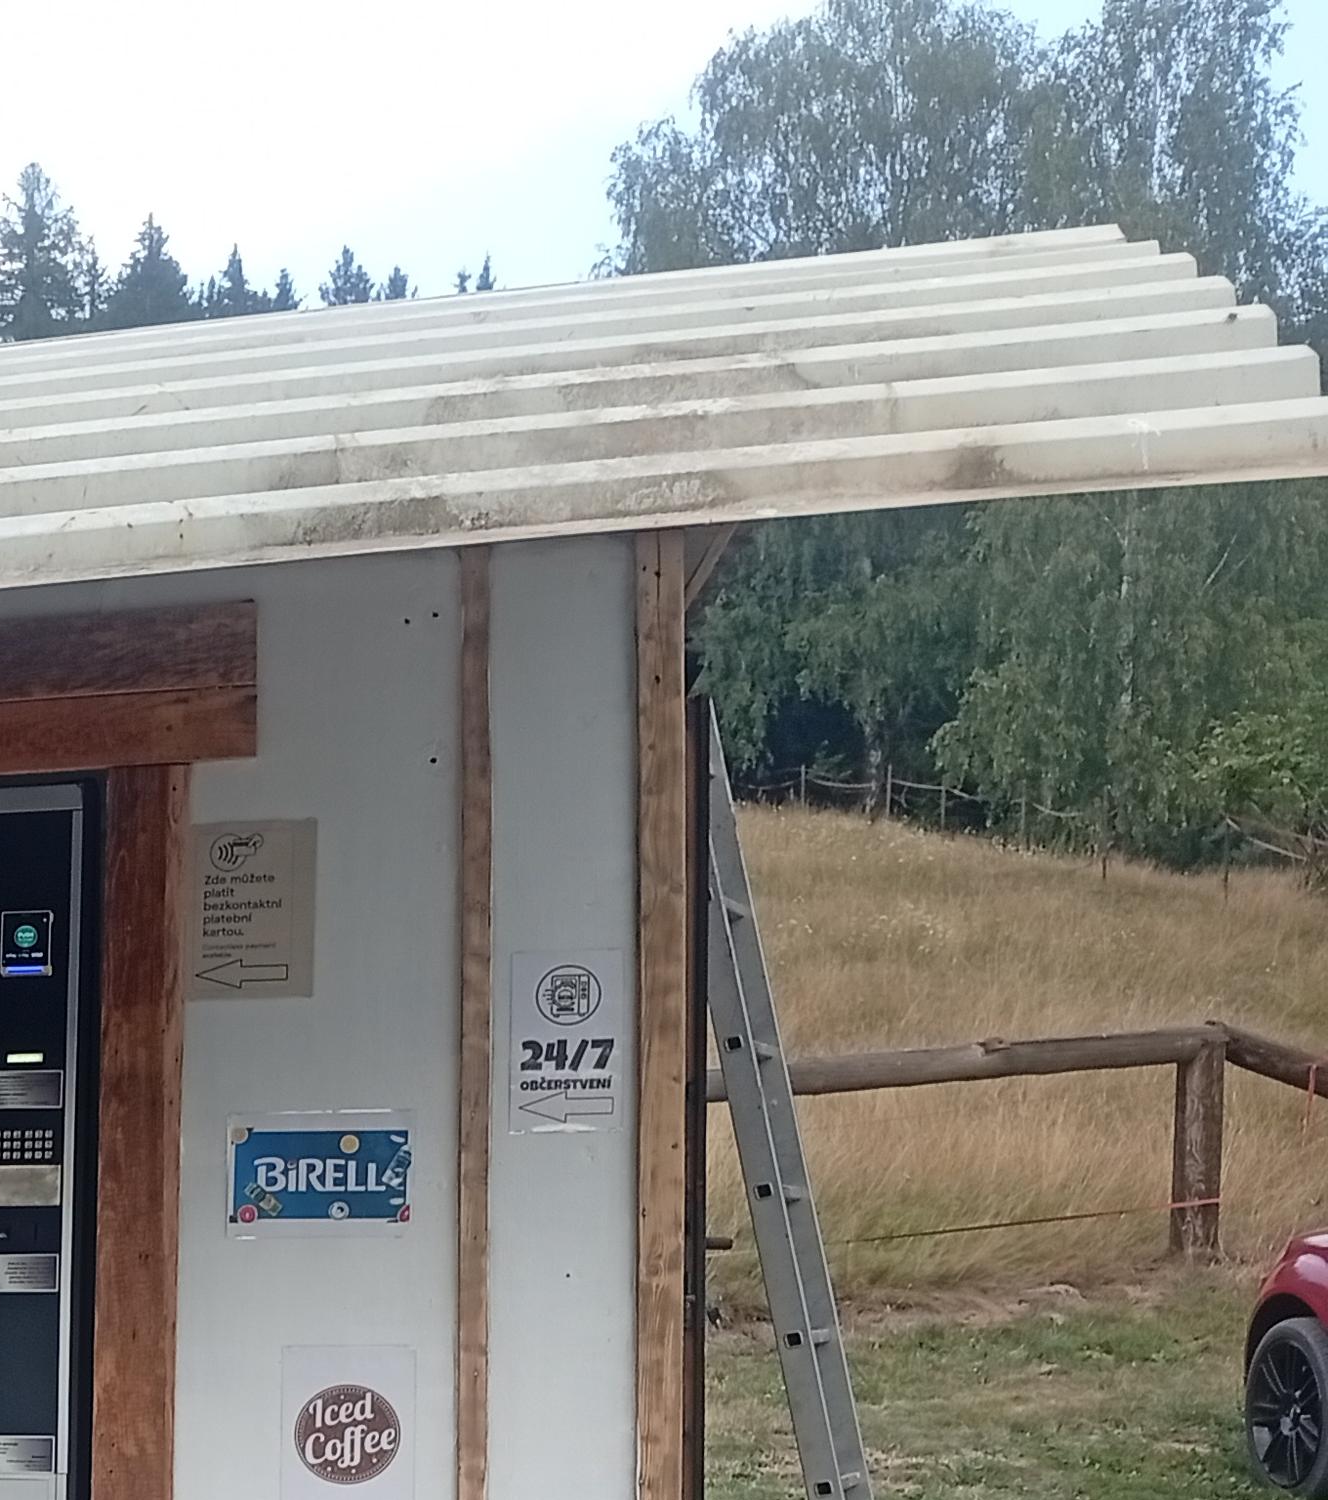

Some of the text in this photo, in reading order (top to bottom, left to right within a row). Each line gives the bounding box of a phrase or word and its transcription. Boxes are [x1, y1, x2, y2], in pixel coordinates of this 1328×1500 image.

[205, 872, 276, 885] Zde můžete
[204, 887, 234, 899] platit
[204, 898, 282, 911] bezkontaktní
[204, 912, 252, 925] platební
[520, 1038, 614, 1072] 24/7
[520, 1075, 612, 1091] OBČERSTVENÍ
[308, 1391, 375, 1428] Iced
[305, 1424, 395, 1468] Coffee
